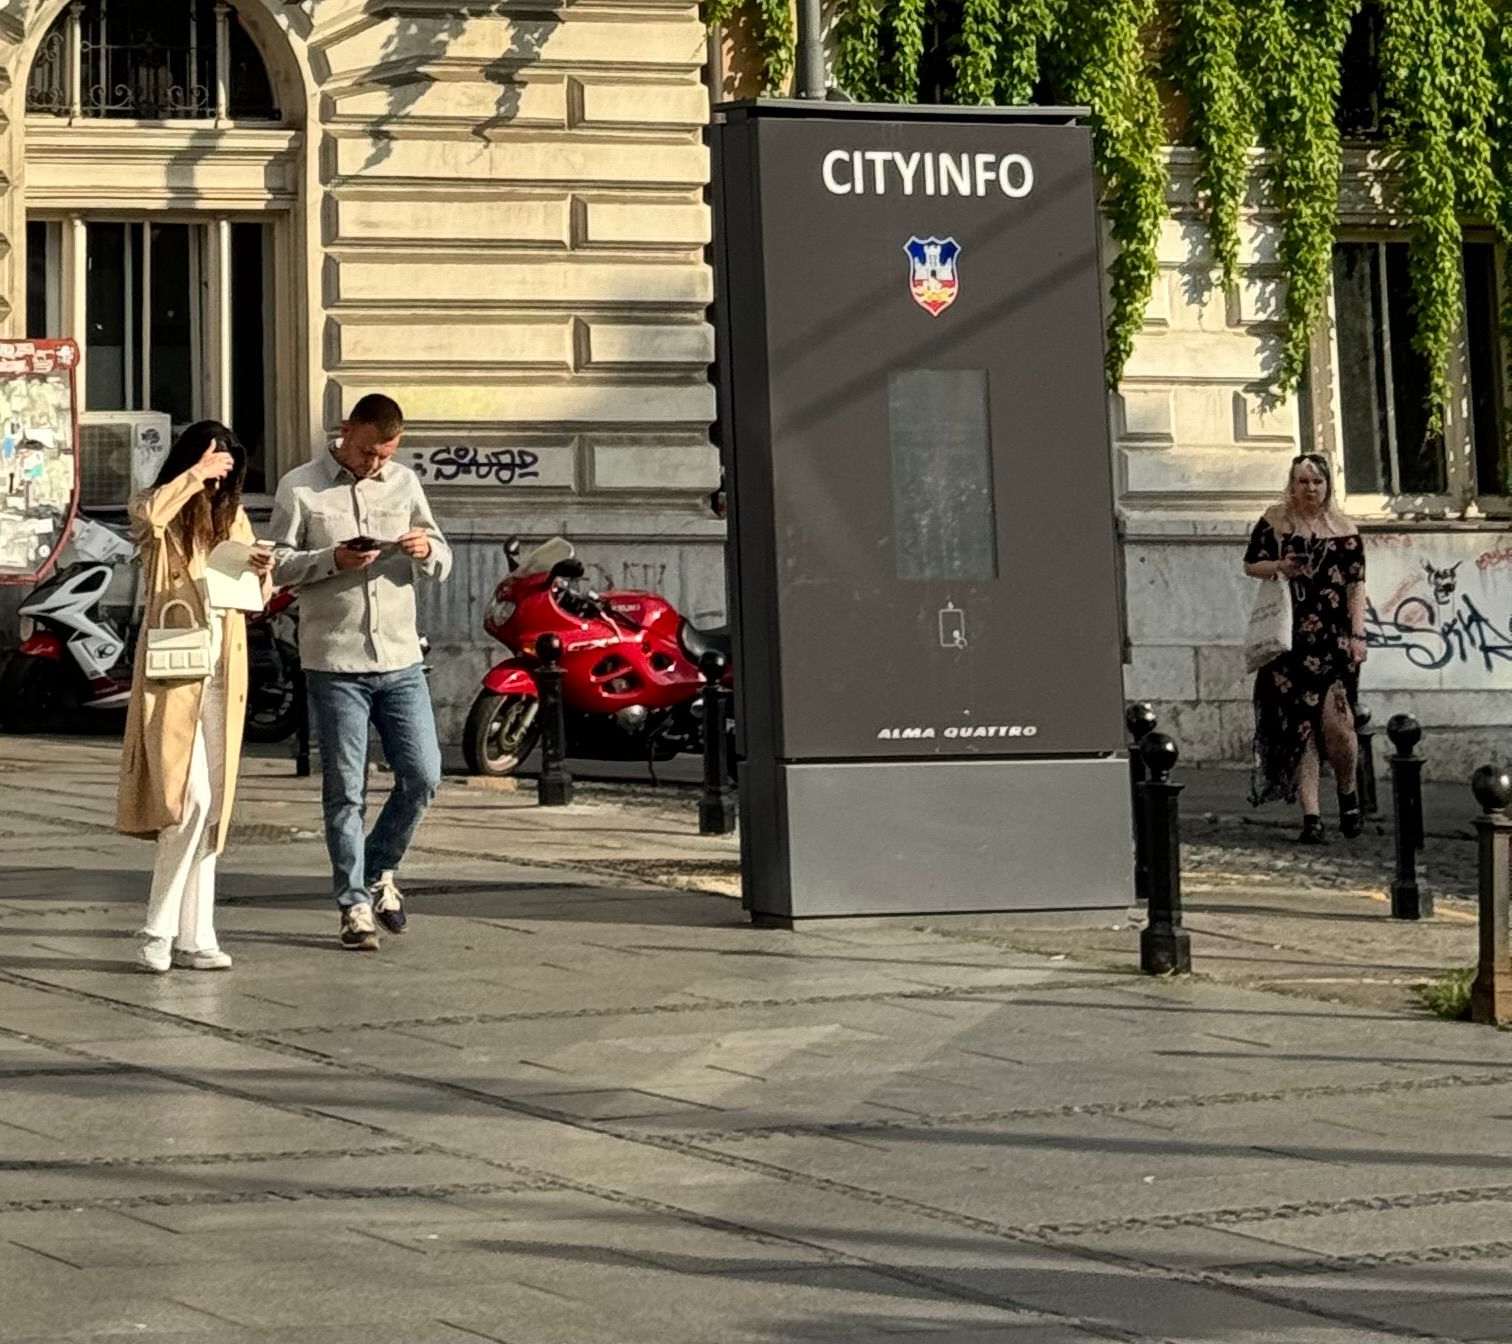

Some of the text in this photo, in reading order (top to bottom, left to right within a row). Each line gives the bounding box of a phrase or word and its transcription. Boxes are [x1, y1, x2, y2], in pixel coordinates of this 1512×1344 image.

[822, 149, 1035, 198] CITYINFO
[877, 725, 1038, 739] ALMA QUATTRO
